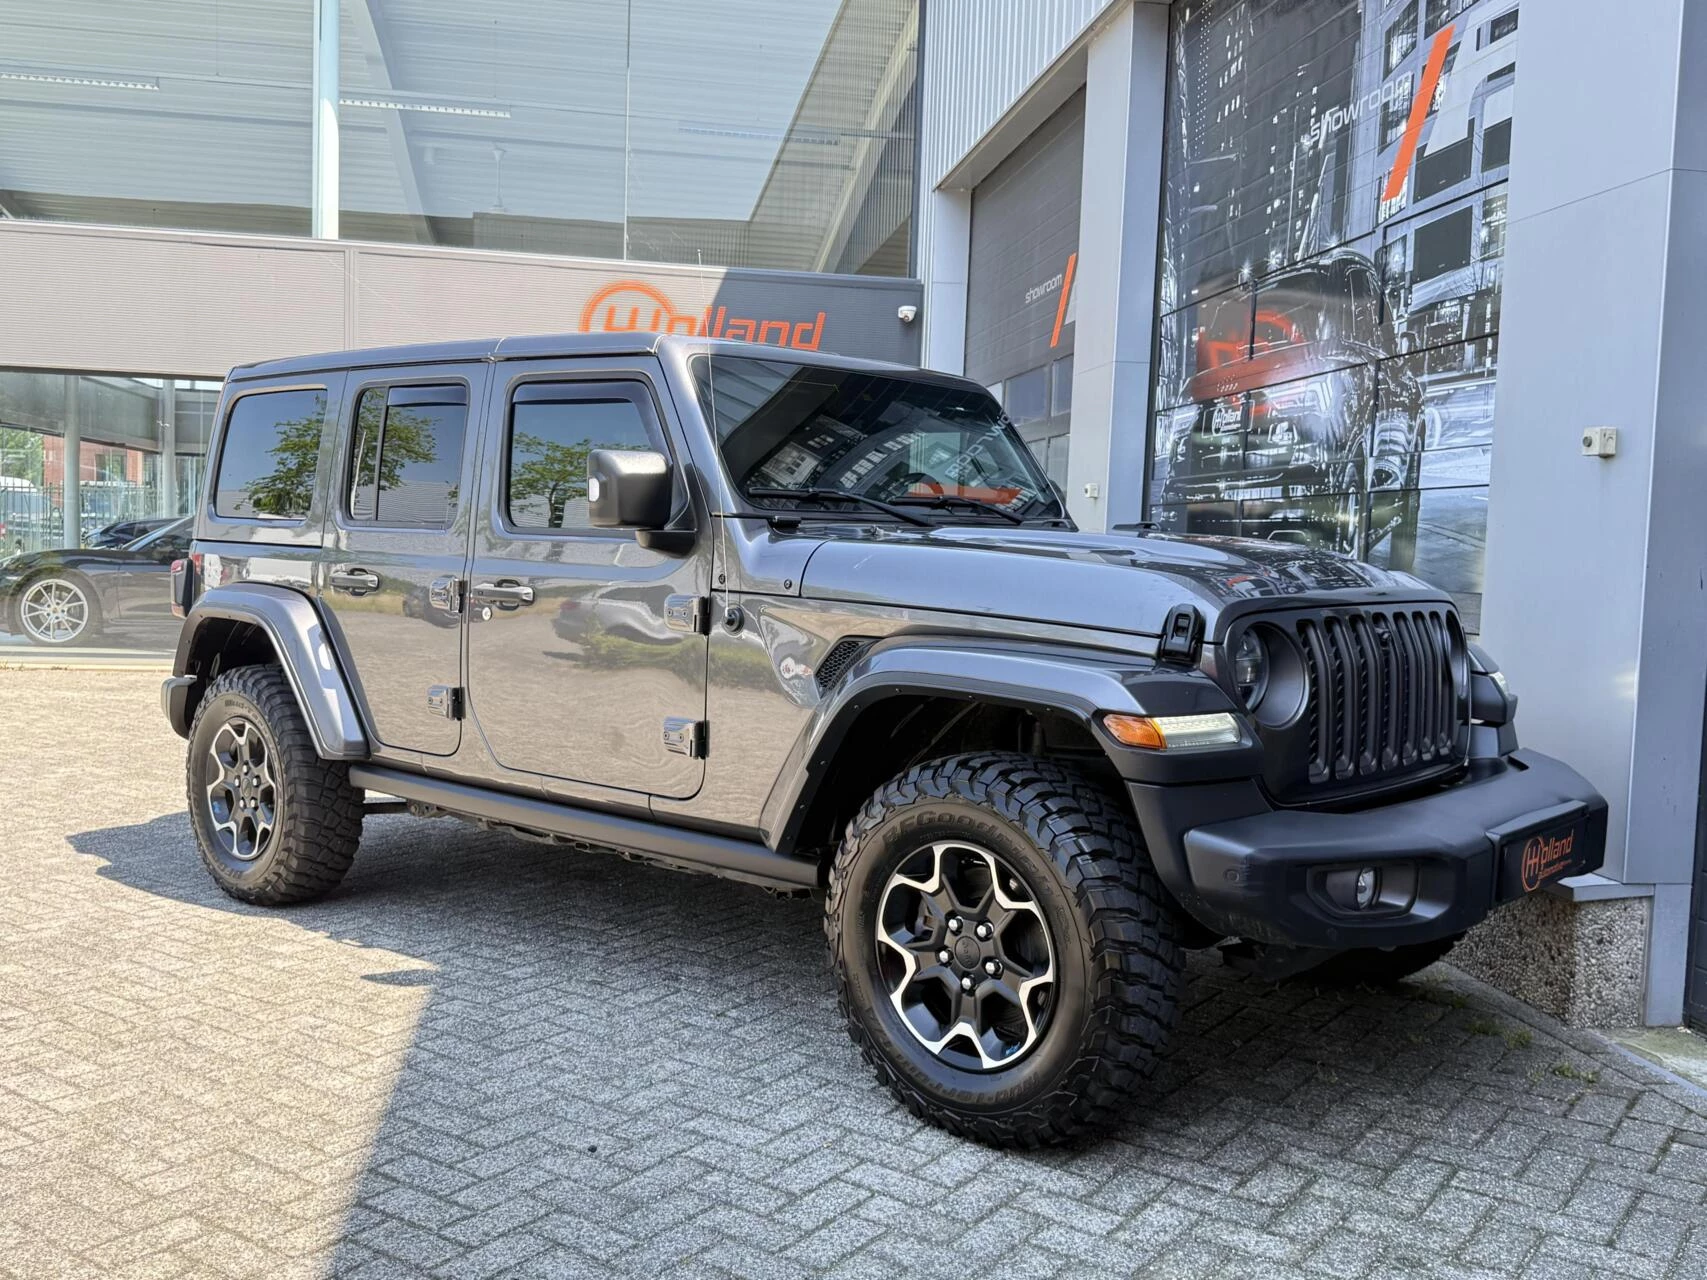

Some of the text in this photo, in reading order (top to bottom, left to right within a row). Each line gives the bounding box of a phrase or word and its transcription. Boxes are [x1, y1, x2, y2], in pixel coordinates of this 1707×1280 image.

[1310, 70, 1413, 145] showroom
[1025, 273, 1063, 304] showroom
[1521, 829, 1574, 892] Holland
